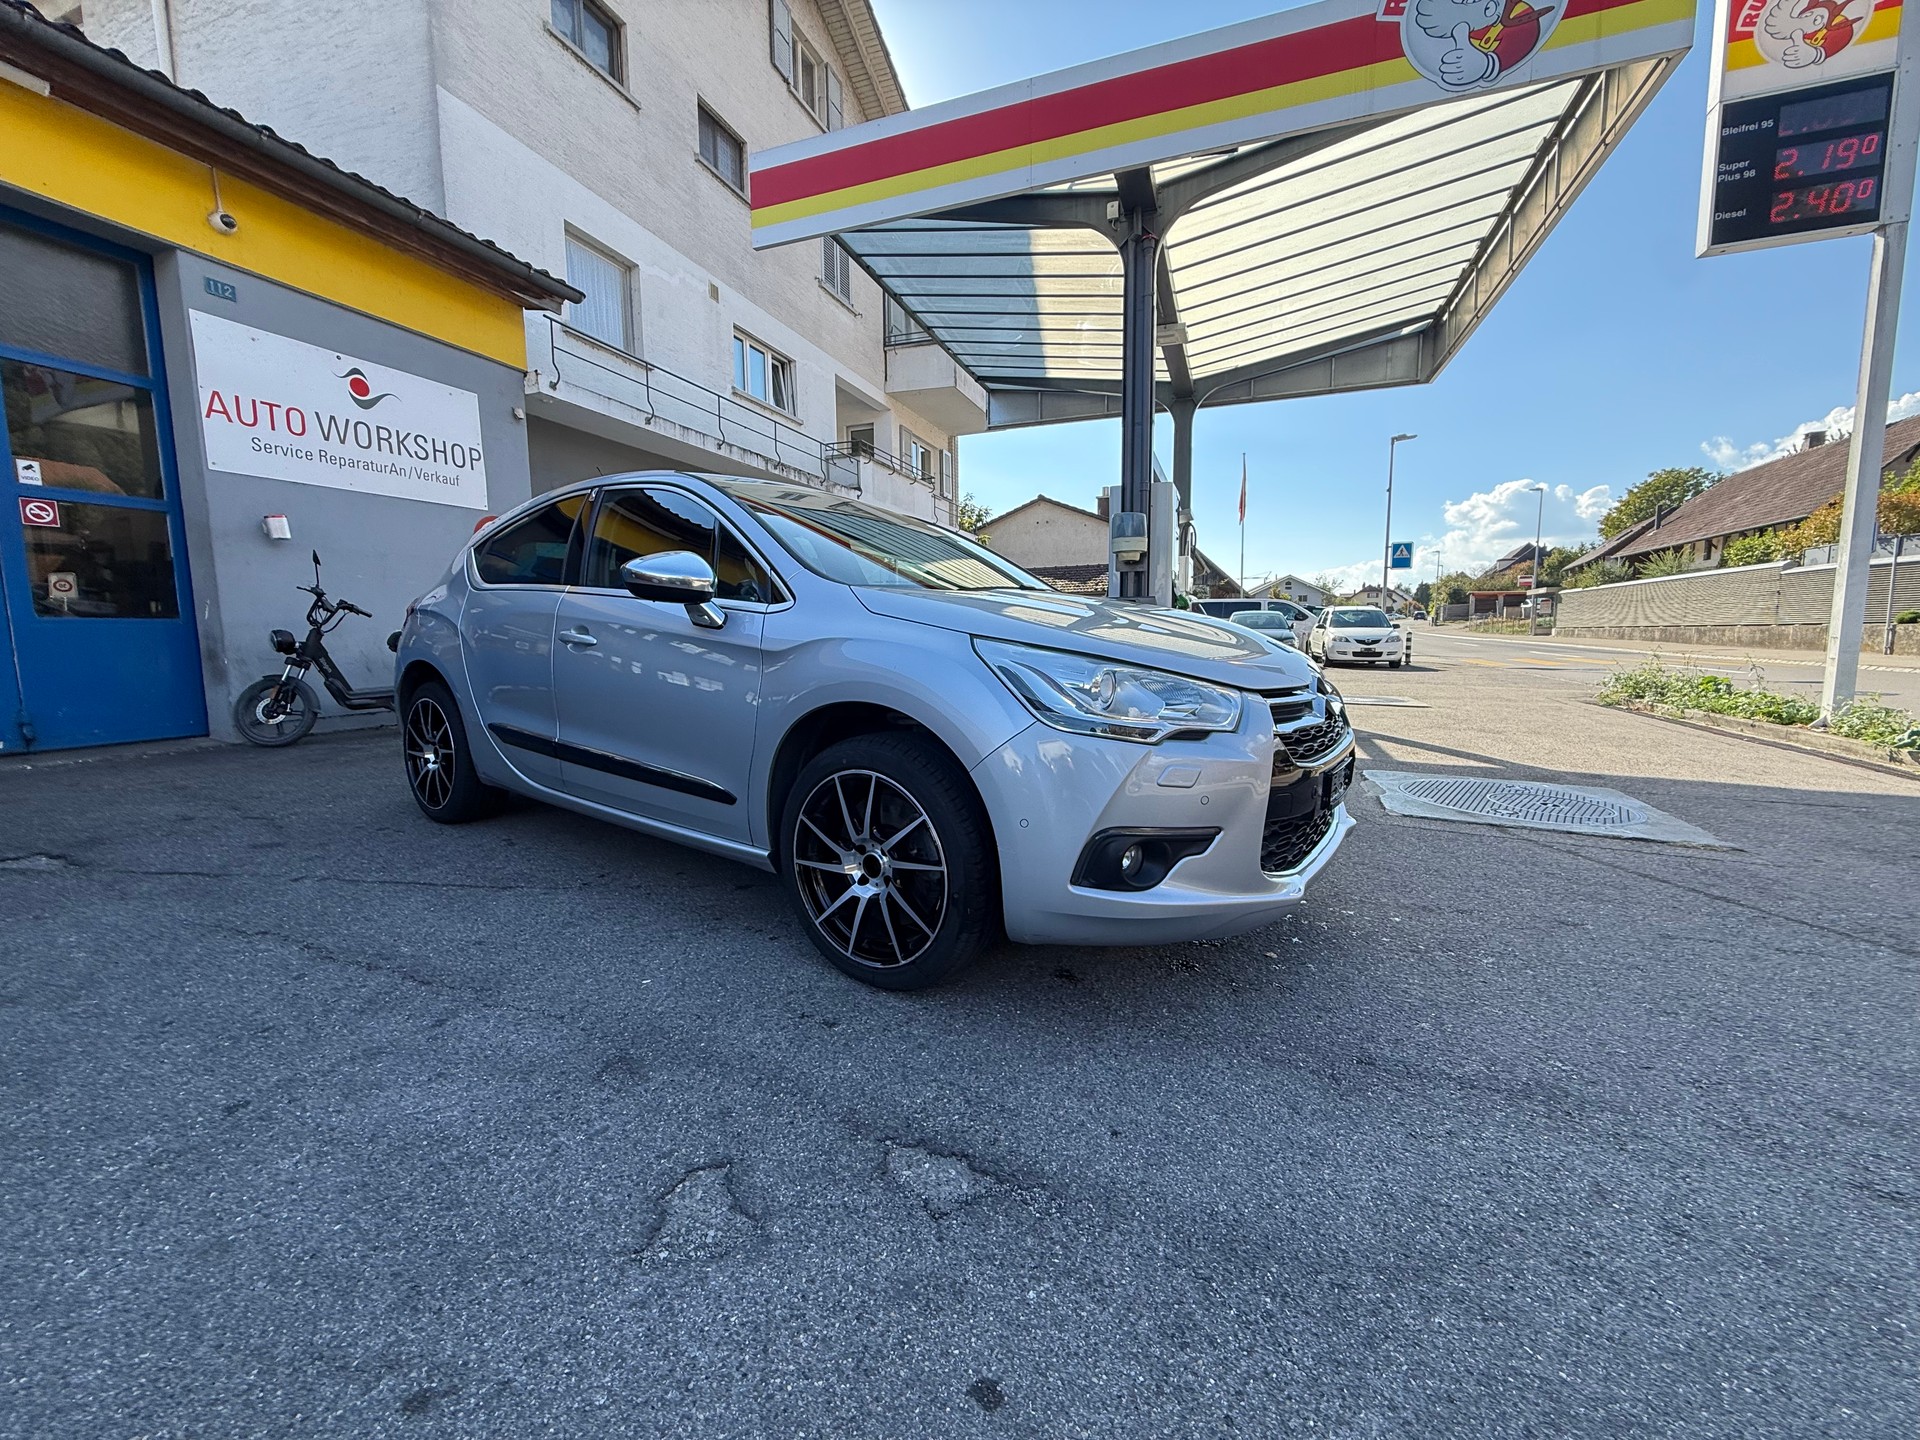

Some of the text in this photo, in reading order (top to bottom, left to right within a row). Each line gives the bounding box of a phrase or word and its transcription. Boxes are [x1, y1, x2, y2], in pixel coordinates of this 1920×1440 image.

[1722, 121, 1759, 136] Bleifrei
[1761, 119, 1774, 129] 95
[1719, 159, 1750, 172] Super
[1718, 169, 1756, 183] Plus 98
[1715, 208, 1747, 220] Diesel
[209, 280, 233, 298] 112
[205, 390, 482, 471] AUTO WORKSHOP
[251, 436, 313, 462] Service
